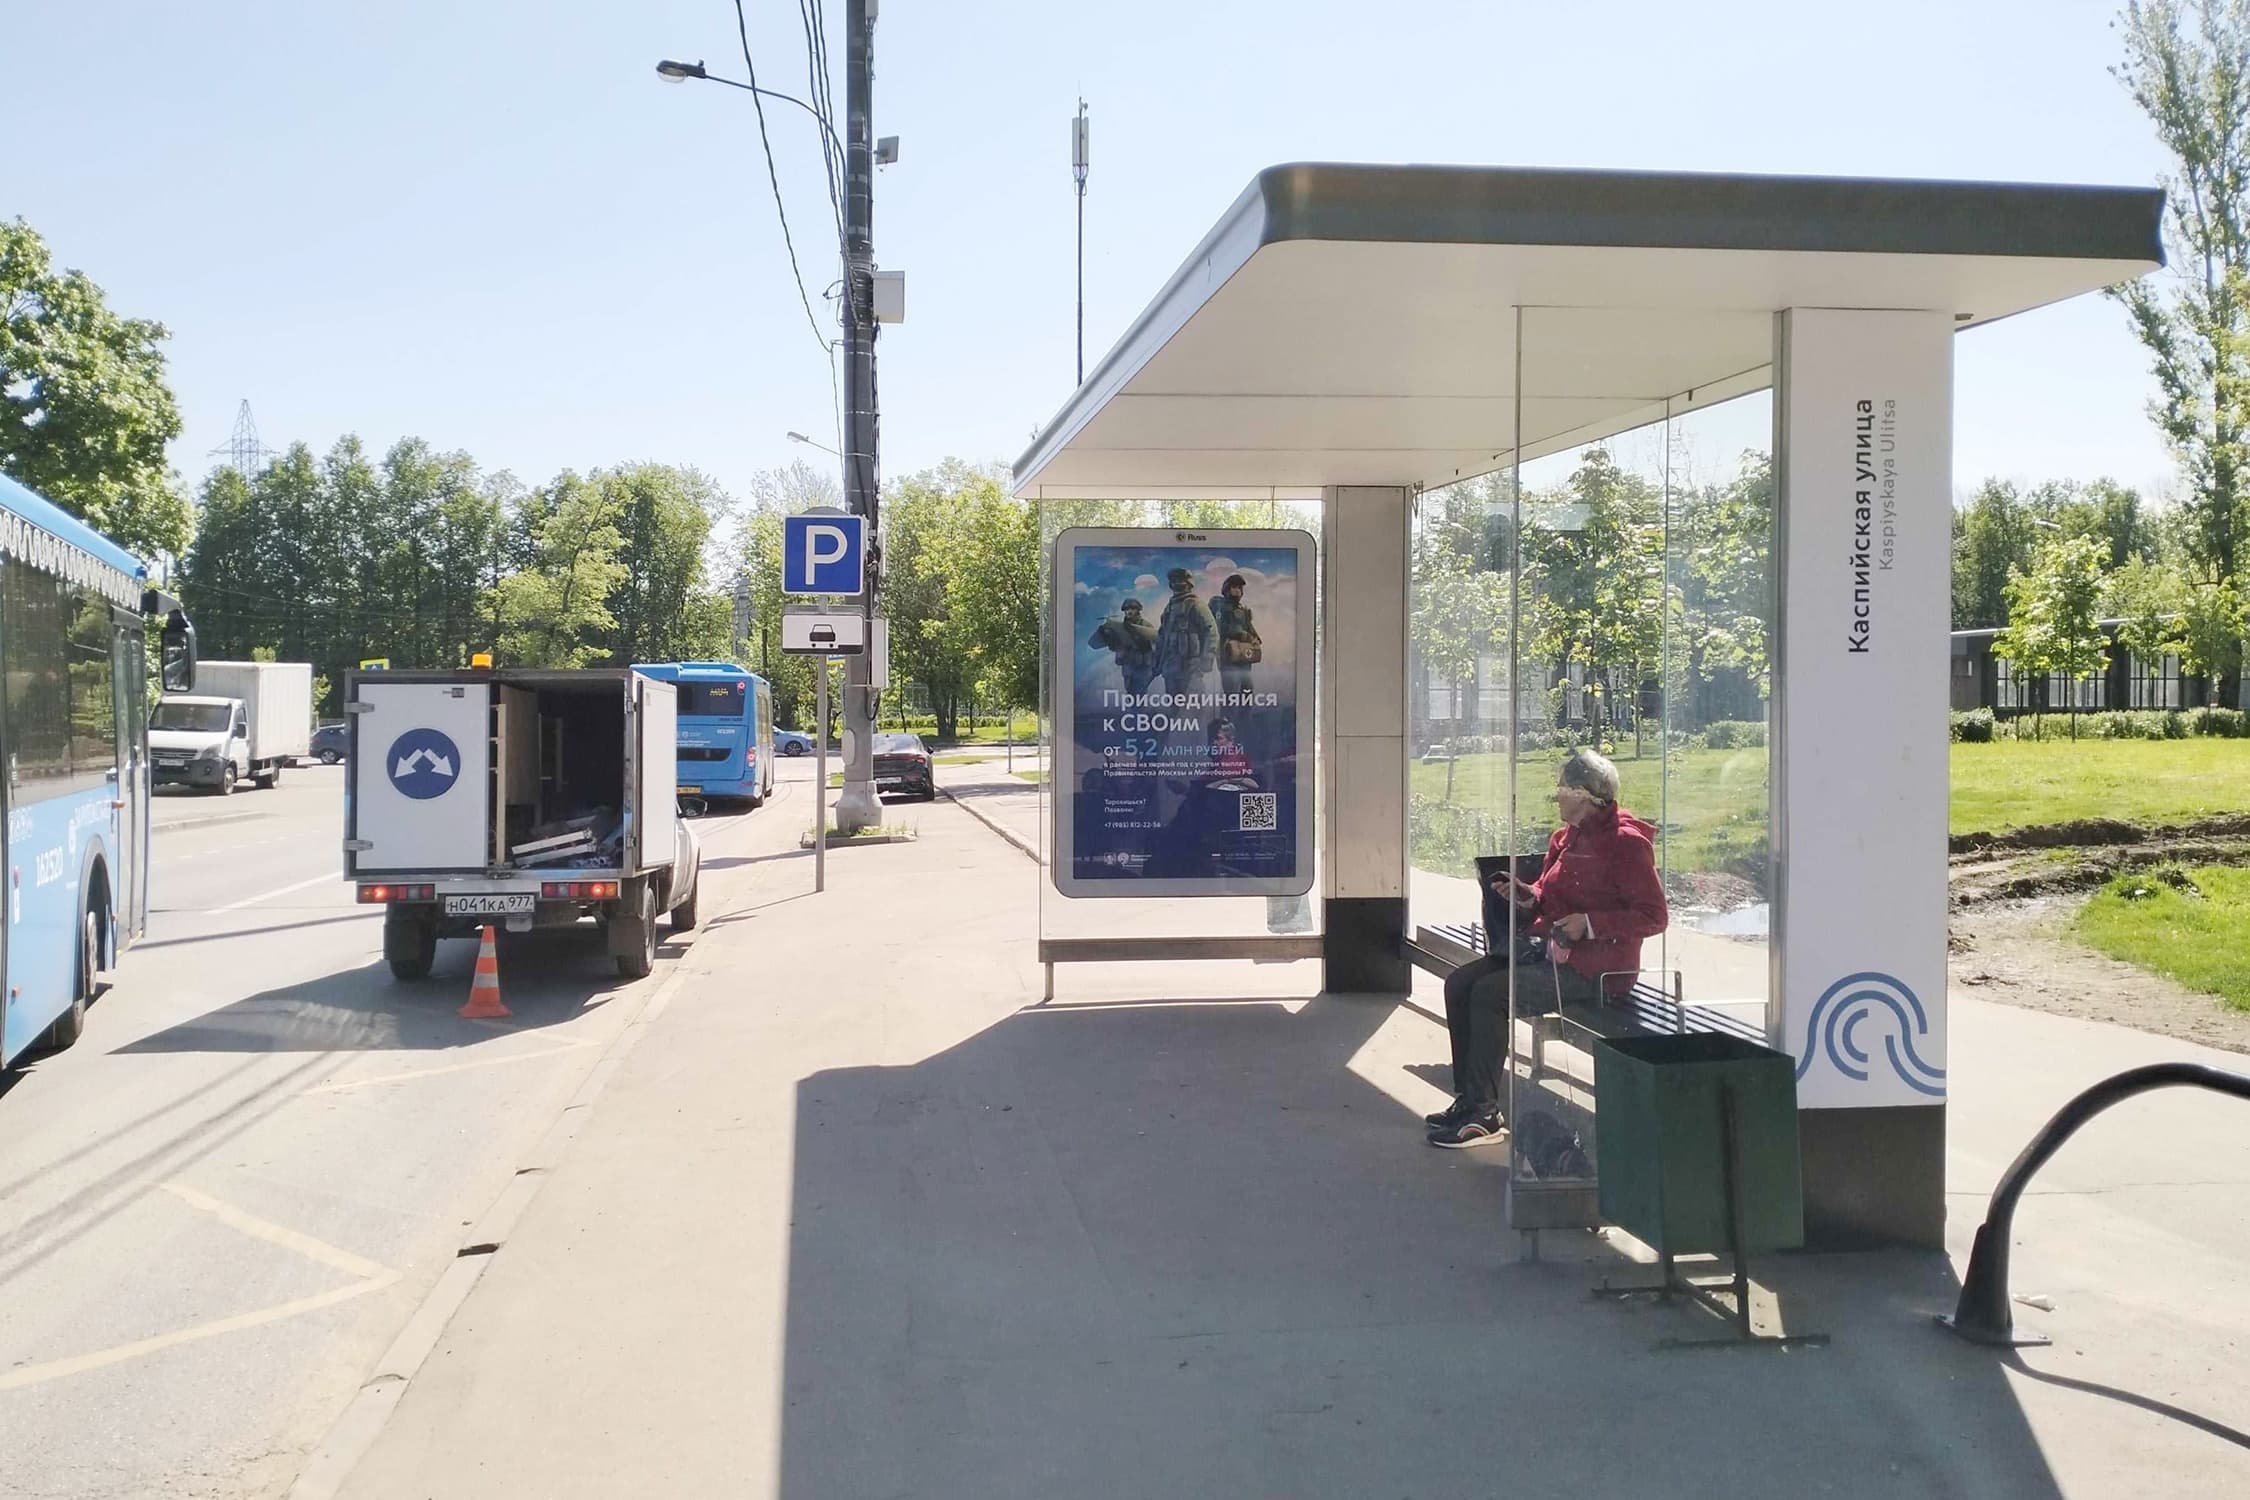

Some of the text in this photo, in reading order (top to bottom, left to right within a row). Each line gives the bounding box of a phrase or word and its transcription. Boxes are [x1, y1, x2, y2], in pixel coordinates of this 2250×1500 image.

[1879, 399, 1898, 570] Kaspiyskaya Ulitsa
[1848, 399, 1876, 653] Каспийская улица
[805, 524, 848, 586] P
[1103, 689, 1278, 711] Присоединяйся
[1103, 713, 1200, 732] к СВОим
[1125, 738, 1158, 760] 5,2
[1103, 769, 1157, 778] Правительства
[1158, 769, 1187, 777] Москвы
[1194, 768, 1241, 778] Минобороны
[1242, 768, 1253, 776] РФ
[1176, 761, 1189, 769] год
[449, 896, 530, 912] Н041КА 977
